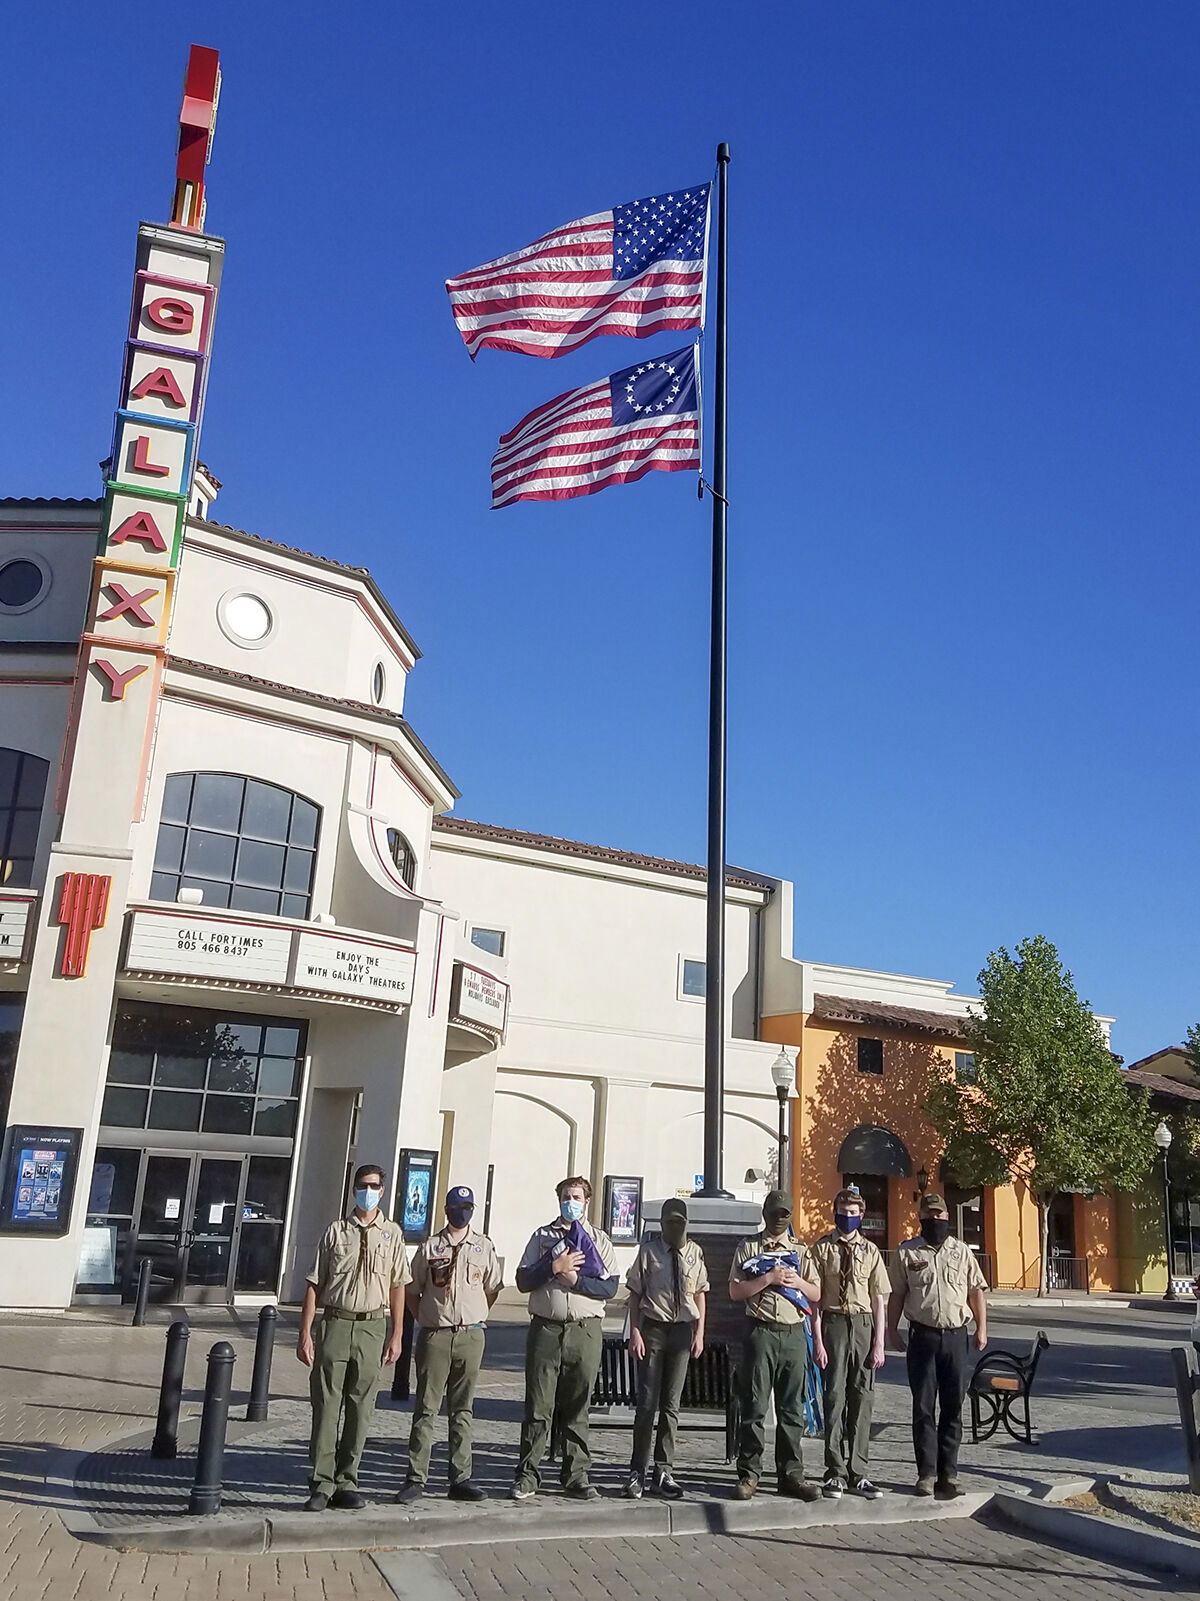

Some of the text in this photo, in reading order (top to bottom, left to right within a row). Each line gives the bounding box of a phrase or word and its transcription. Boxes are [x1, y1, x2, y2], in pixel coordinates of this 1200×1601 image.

[94, 296, 194, 700] GALAXY
[178, 930, 203, 941] CALL
[177, 940, 248, 956] 805 466 8437
[336, 951, 379, 966] ENJOY THE
[348, 963, 370, 974] DAYS
[307, 966, 405, 990] WITH GALAXY THEATRES
